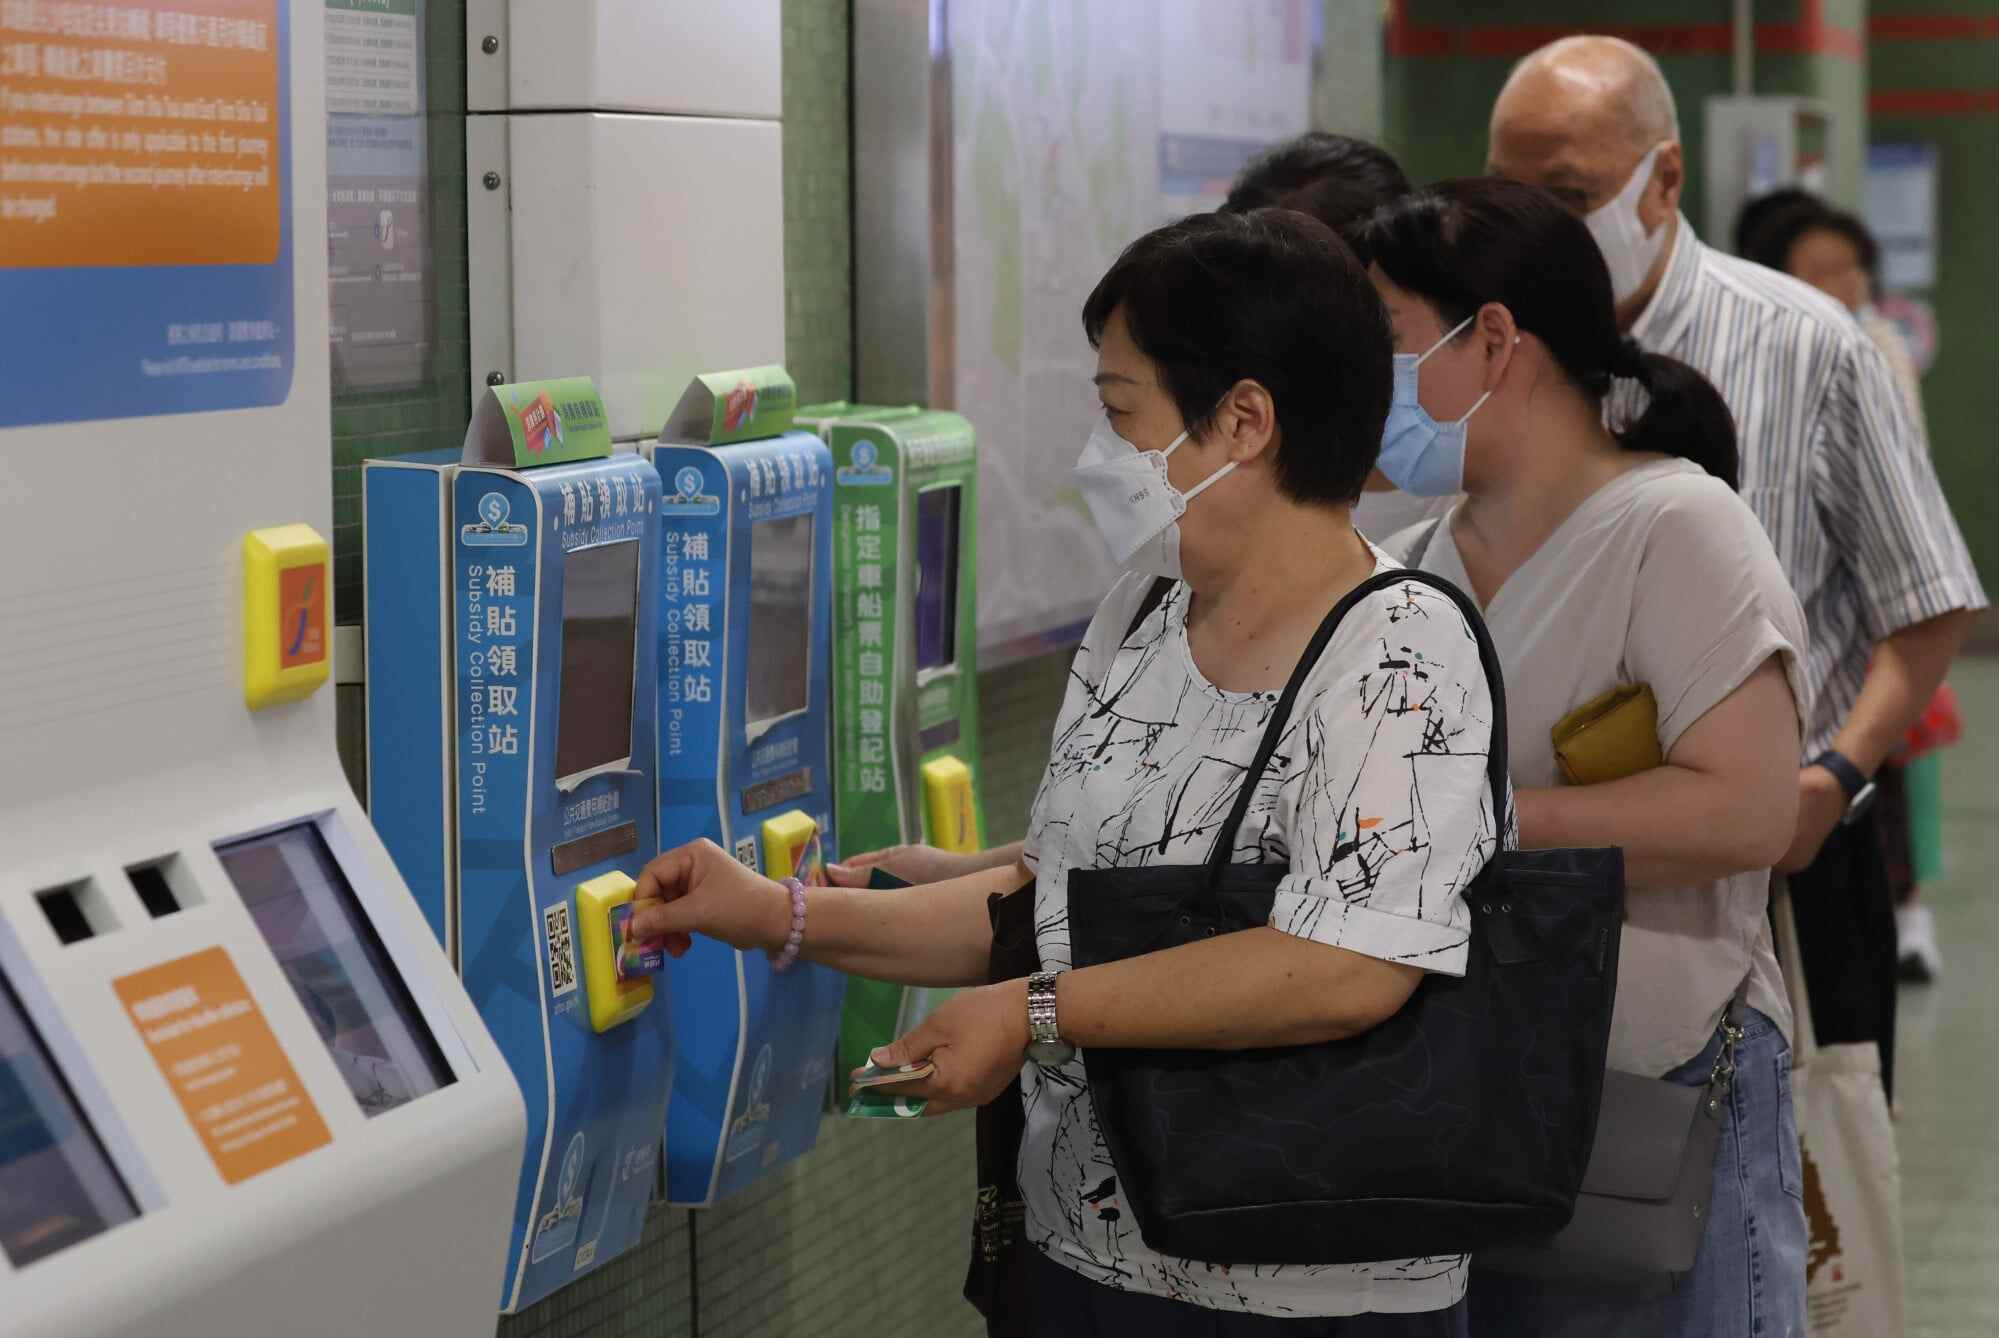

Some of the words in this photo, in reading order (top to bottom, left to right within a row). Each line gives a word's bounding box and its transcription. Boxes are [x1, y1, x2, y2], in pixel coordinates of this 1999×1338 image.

[559, 472, 645, 528] 補貼領取站
[561, 529, 589, 549] Subsidy
[590, 523, 625, 543] Collection
[468, 565, 484, 644] Subsidy
[665, 532, 680, 603] Subsidy
[682, 532, 711, 702] 補貼領取站
[486, 565, 518, 755] 補貼領取站
[667, 609, 683, 703] Collection
[470, 651, 485, 754] Collection
[669, 708, 683, 756] Point
[471, 762, 487, 814] Point
